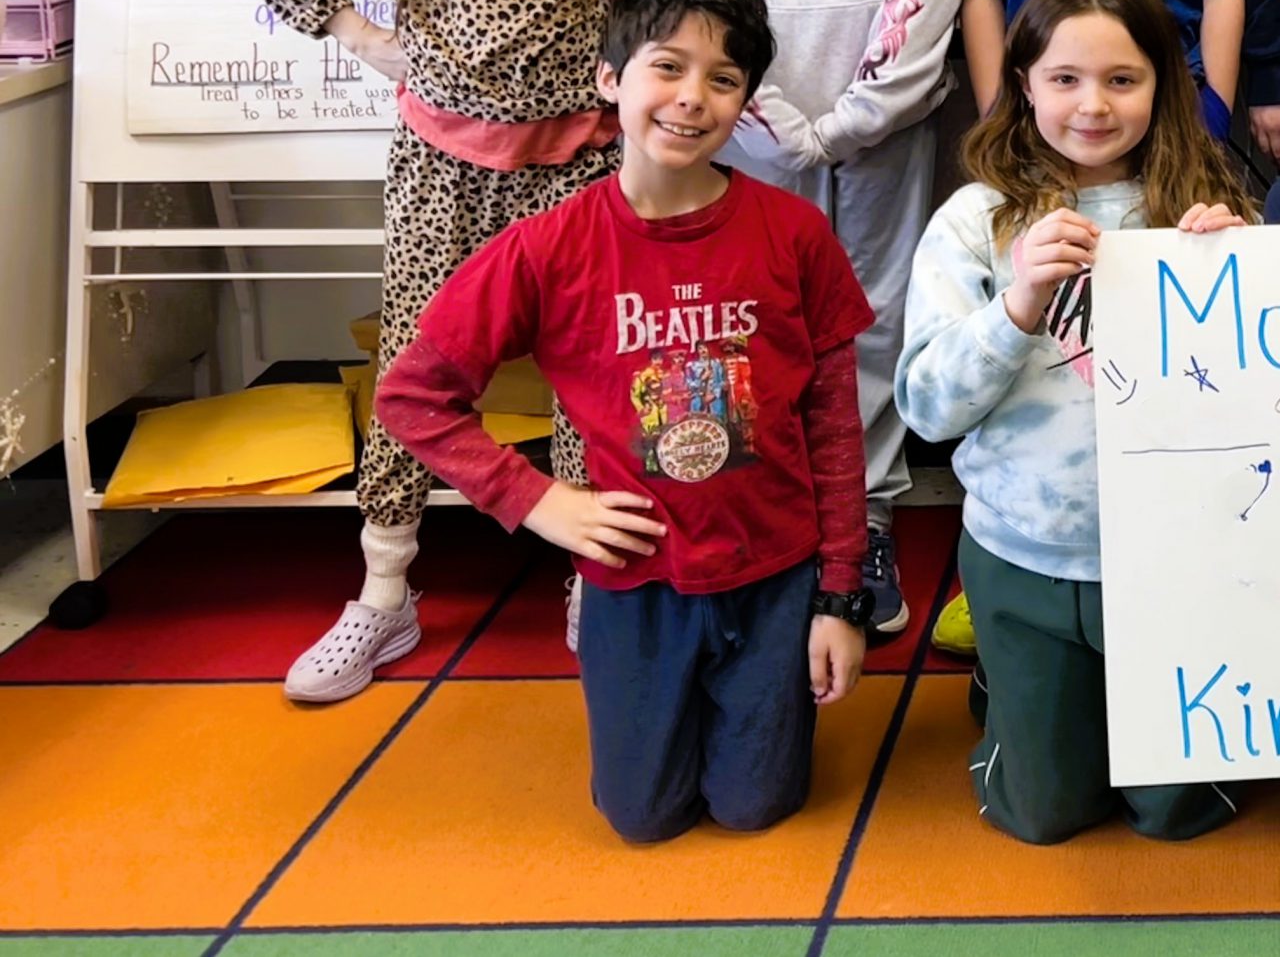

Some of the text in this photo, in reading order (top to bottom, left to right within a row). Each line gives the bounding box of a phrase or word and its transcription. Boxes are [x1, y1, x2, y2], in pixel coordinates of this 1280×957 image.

[151, 41, 362, 85] Remember the
[199, 84, 241, 101] Treat
[256, 82, 303, 100] others
[323, 81, 347, 99] the
[242, 102, 259, 120] to
[277, 102, 298, 119] be
[672, 283, 702, 300] THE
[614, 292, 759, 355] BEATLES
